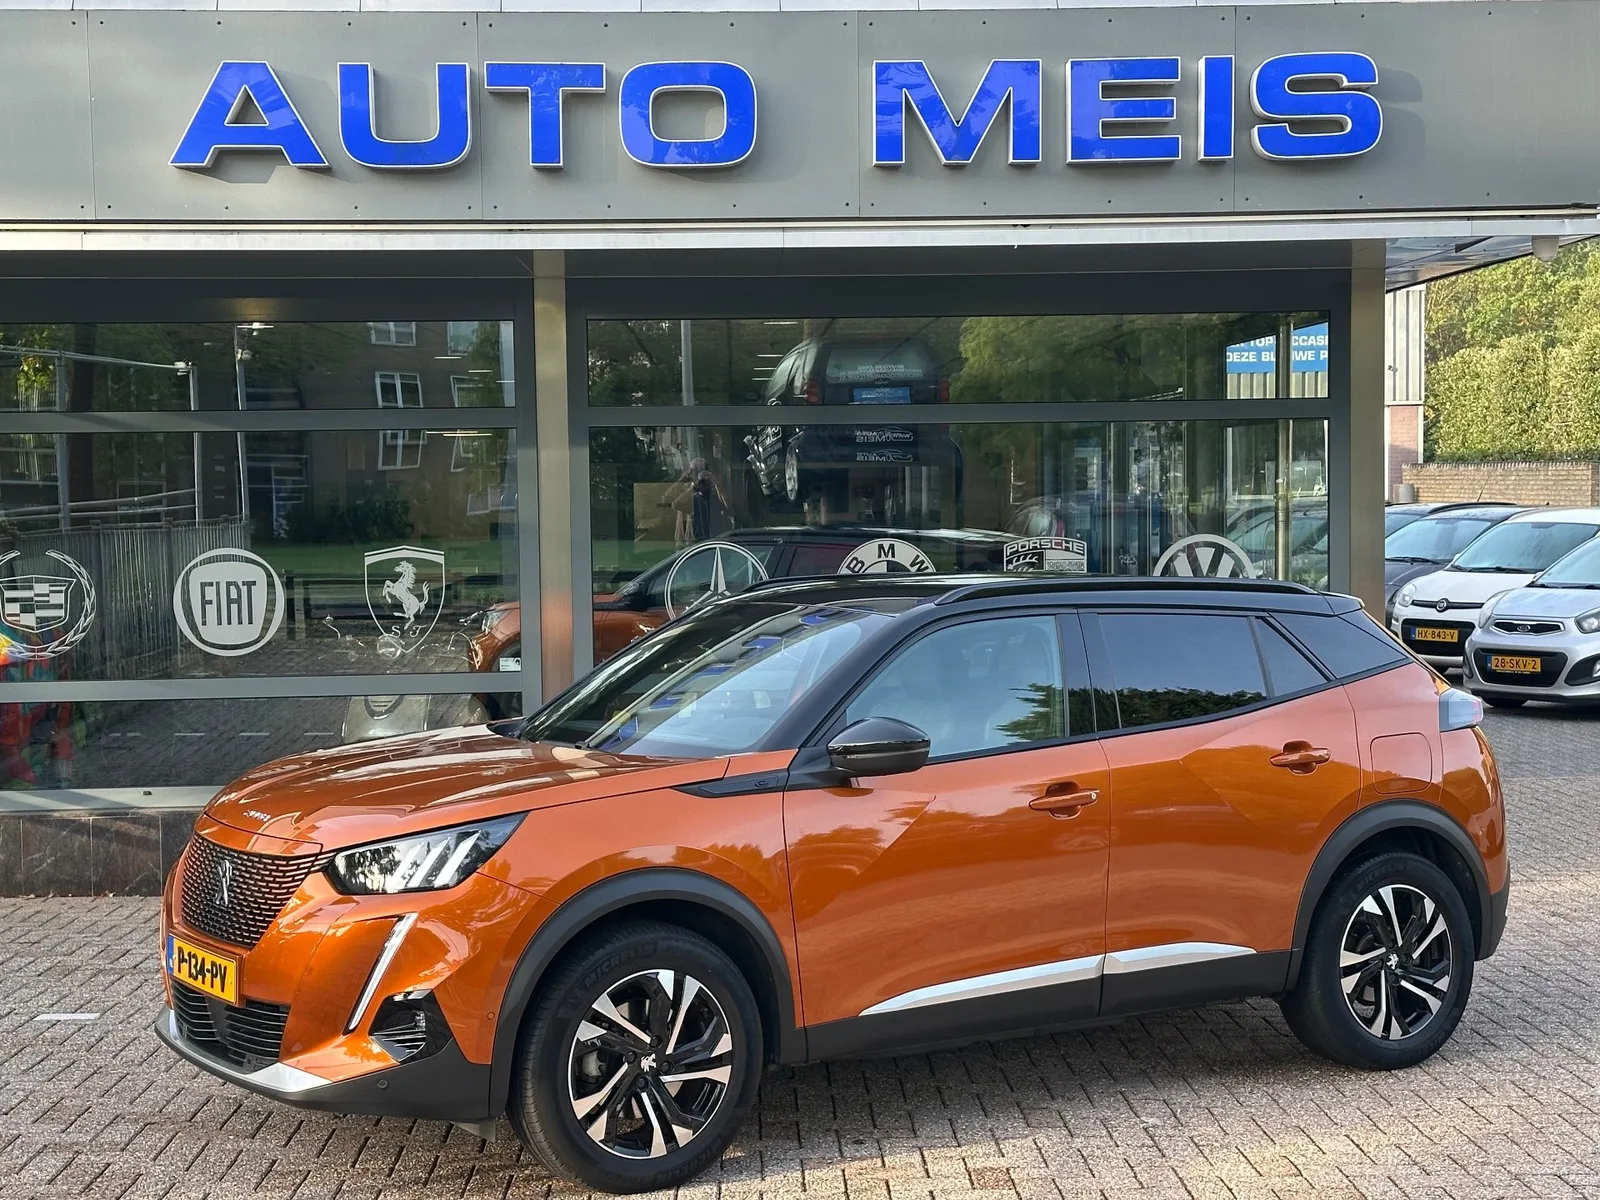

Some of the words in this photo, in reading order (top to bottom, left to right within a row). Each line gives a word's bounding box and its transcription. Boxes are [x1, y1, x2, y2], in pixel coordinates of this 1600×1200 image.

[168, 60, 758, 169] AUTO
[872, 52, 1383, 167] MEIS
[1226, 351, 1257, 362] DEZE
[1007, 539, 1084, 552] PORSCHE
[845, 543, 929, 573] BMW
[200, 580, 257, 626] FIAT
[1417, 629, 1455, 640] HX-843-V
[1494, 657, 1537, 670] 28-SKV-2
[177, 945, 228, 993] P-134-PV
